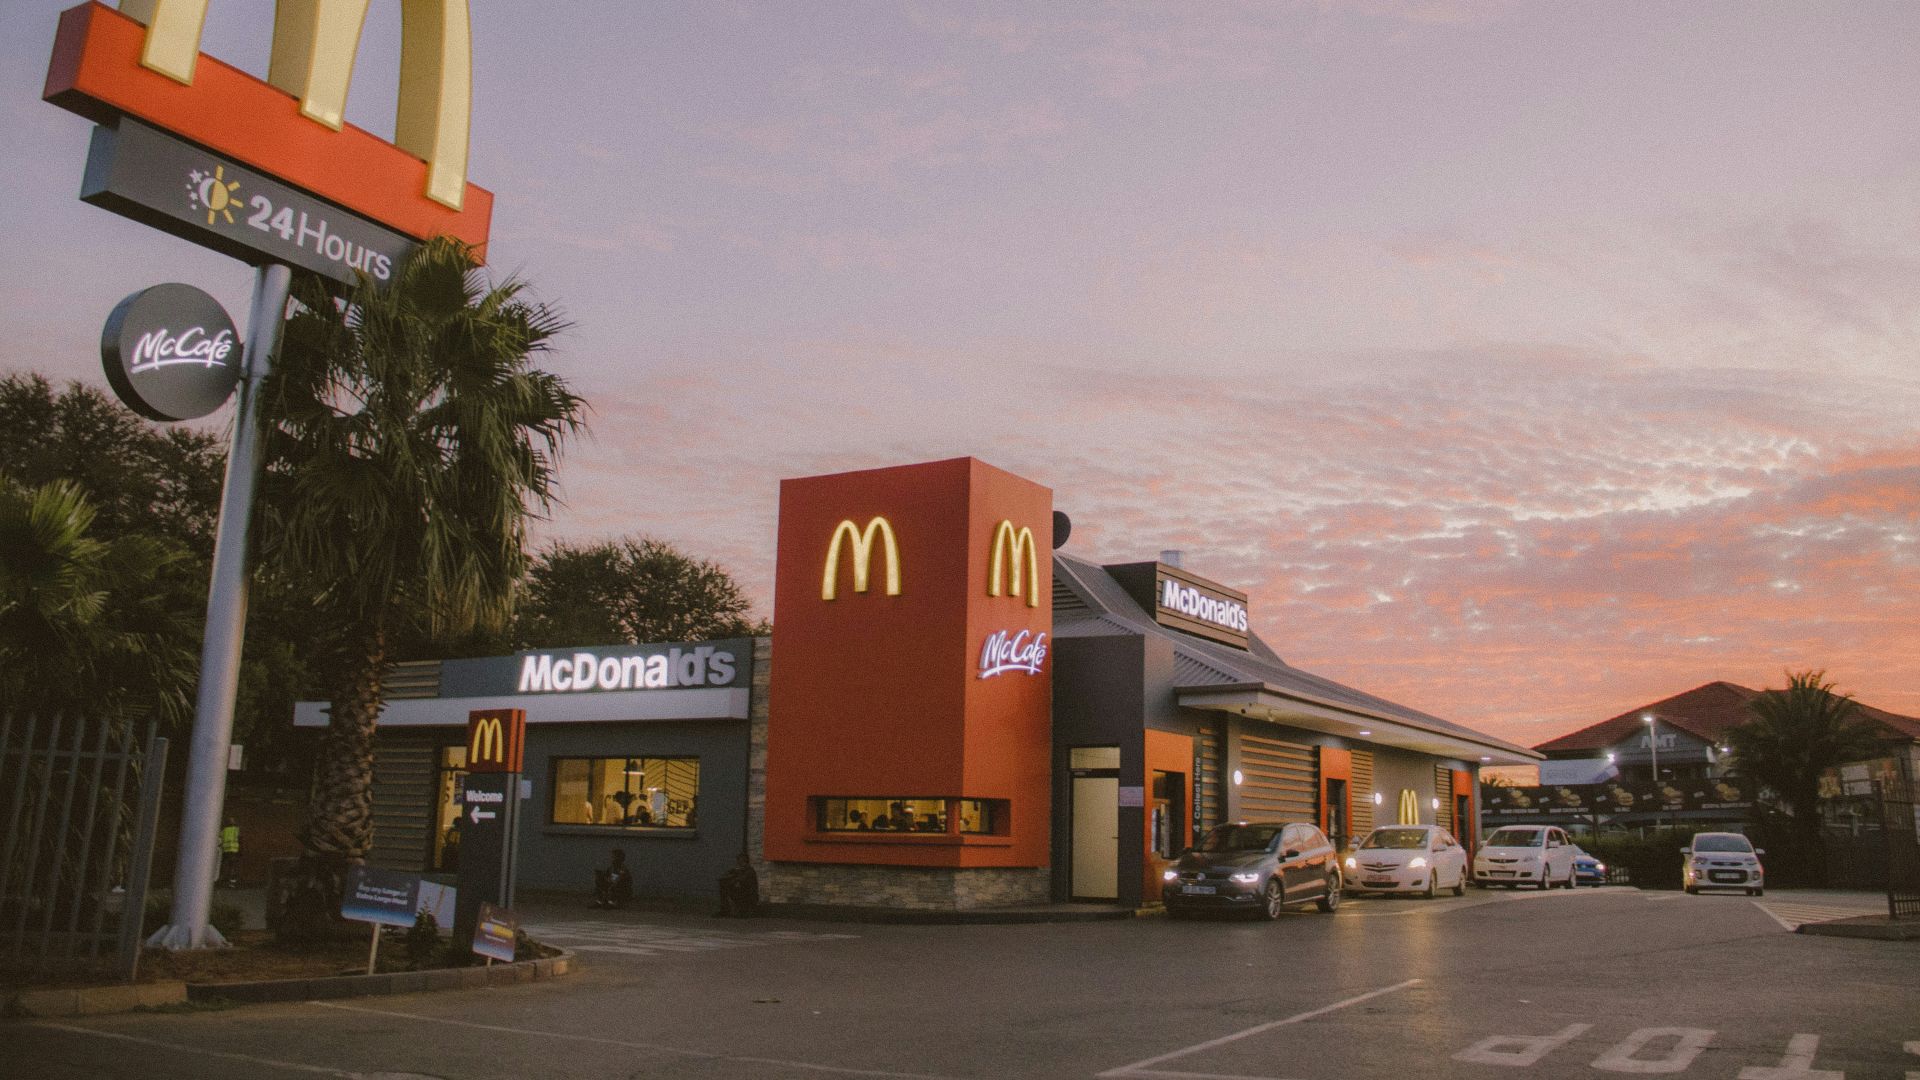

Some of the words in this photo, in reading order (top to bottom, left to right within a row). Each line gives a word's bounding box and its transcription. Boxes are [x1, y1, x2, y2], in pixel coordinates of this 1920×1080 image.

[1162, 580, 1248, 632] McDonald's
[519, 646, 736, 693] McDonald's
[466, 789, 504, 803] Welcome
